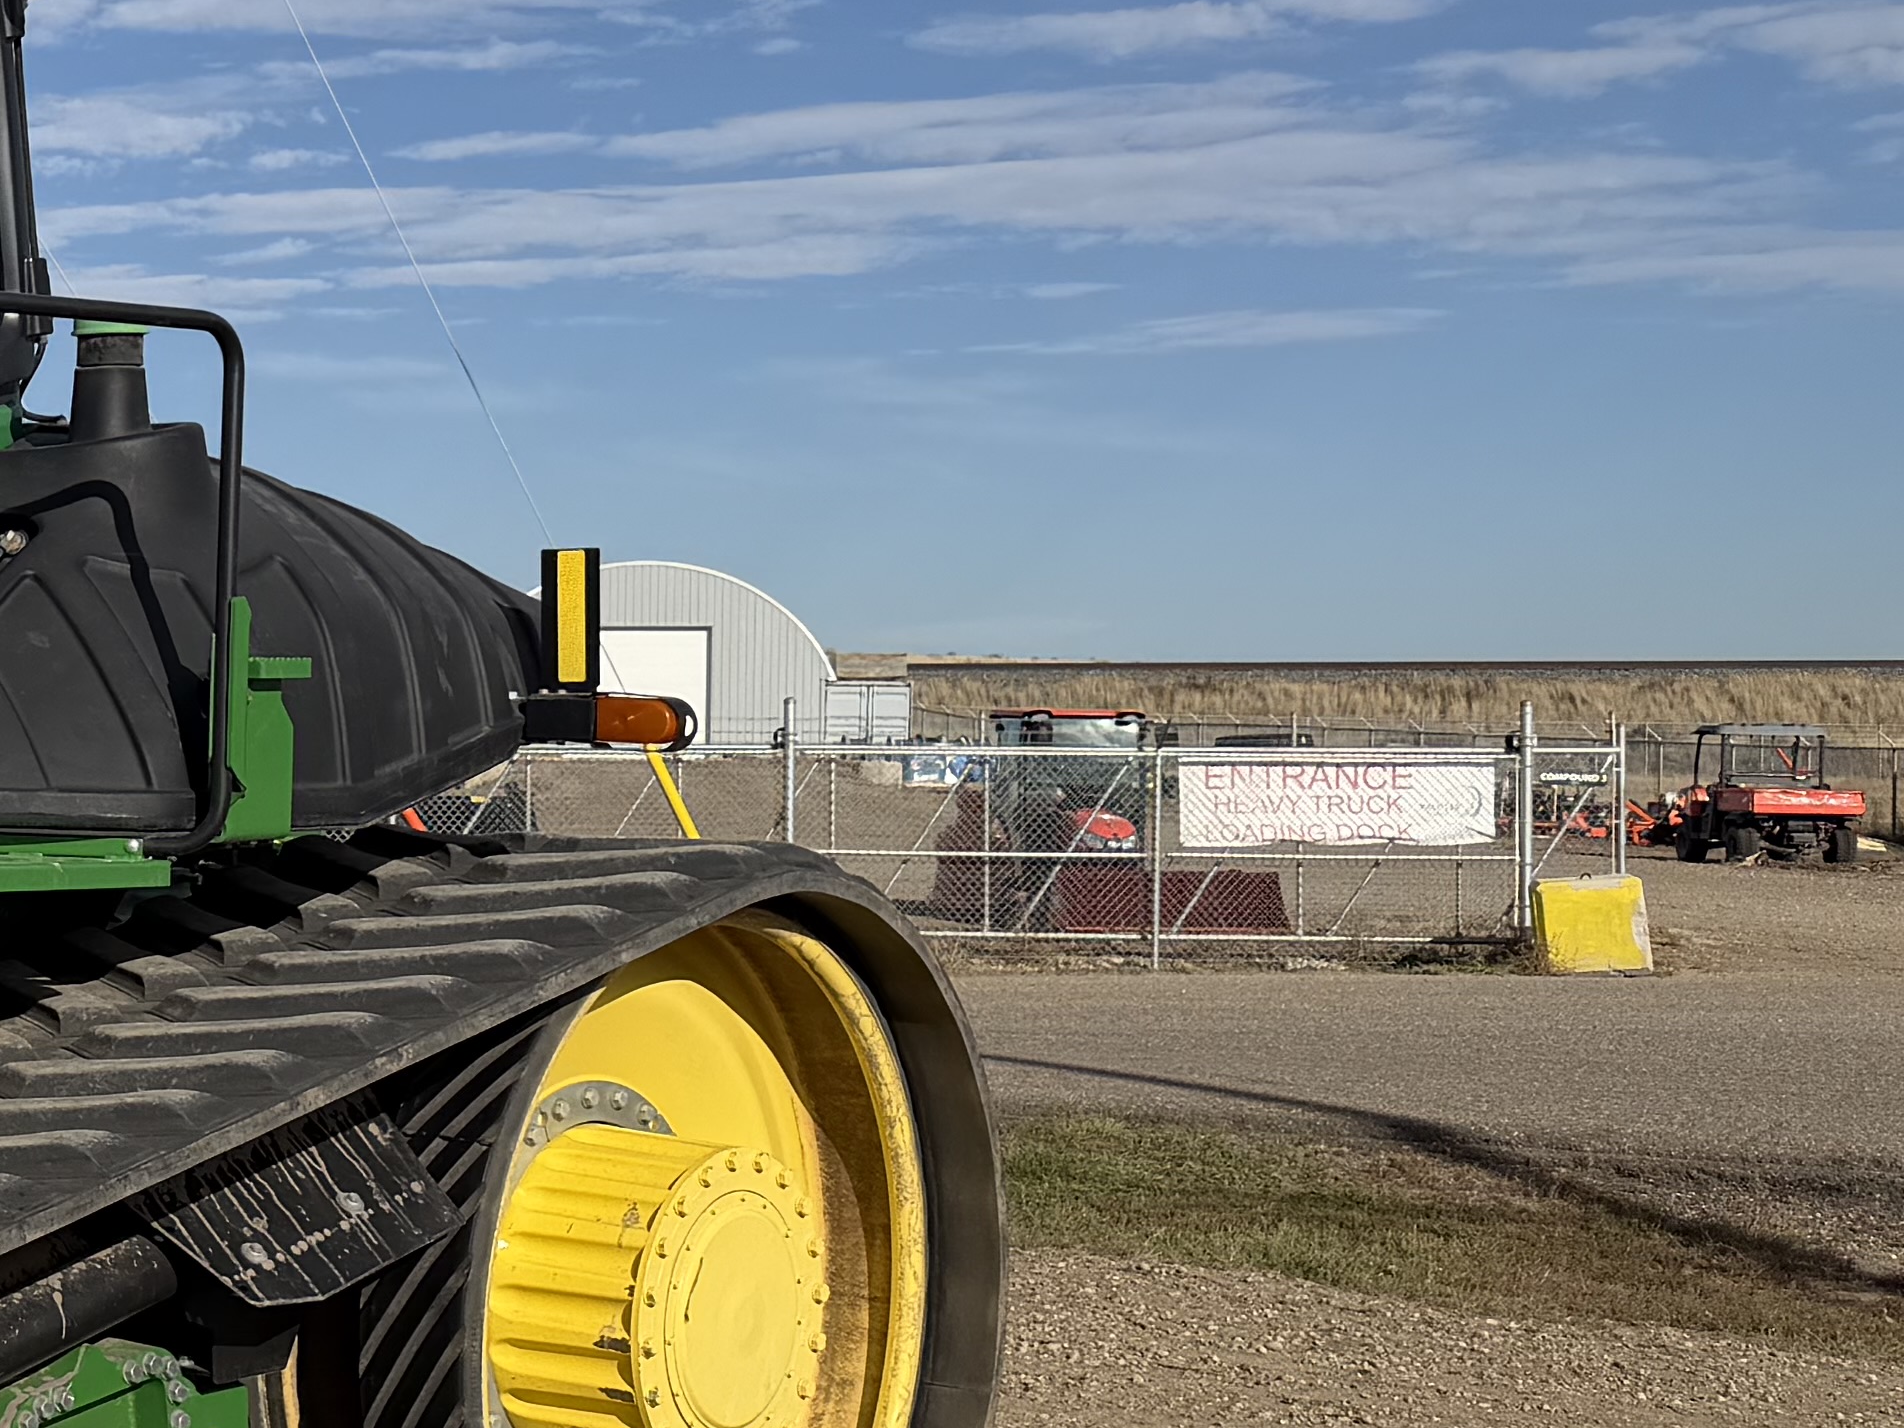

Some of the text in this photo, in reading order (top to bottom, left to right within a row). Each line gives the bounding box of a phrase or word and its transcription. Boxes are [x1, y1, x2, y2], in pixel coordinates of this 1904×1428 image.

[1203, 764, 1414, 791] ENTRANCE
[1213, 794, 1302, 815] HEAVY
[1310, 794, 1404, 815] TRUCK
[1205, 822, 1414, 842] LOADING DOCK
